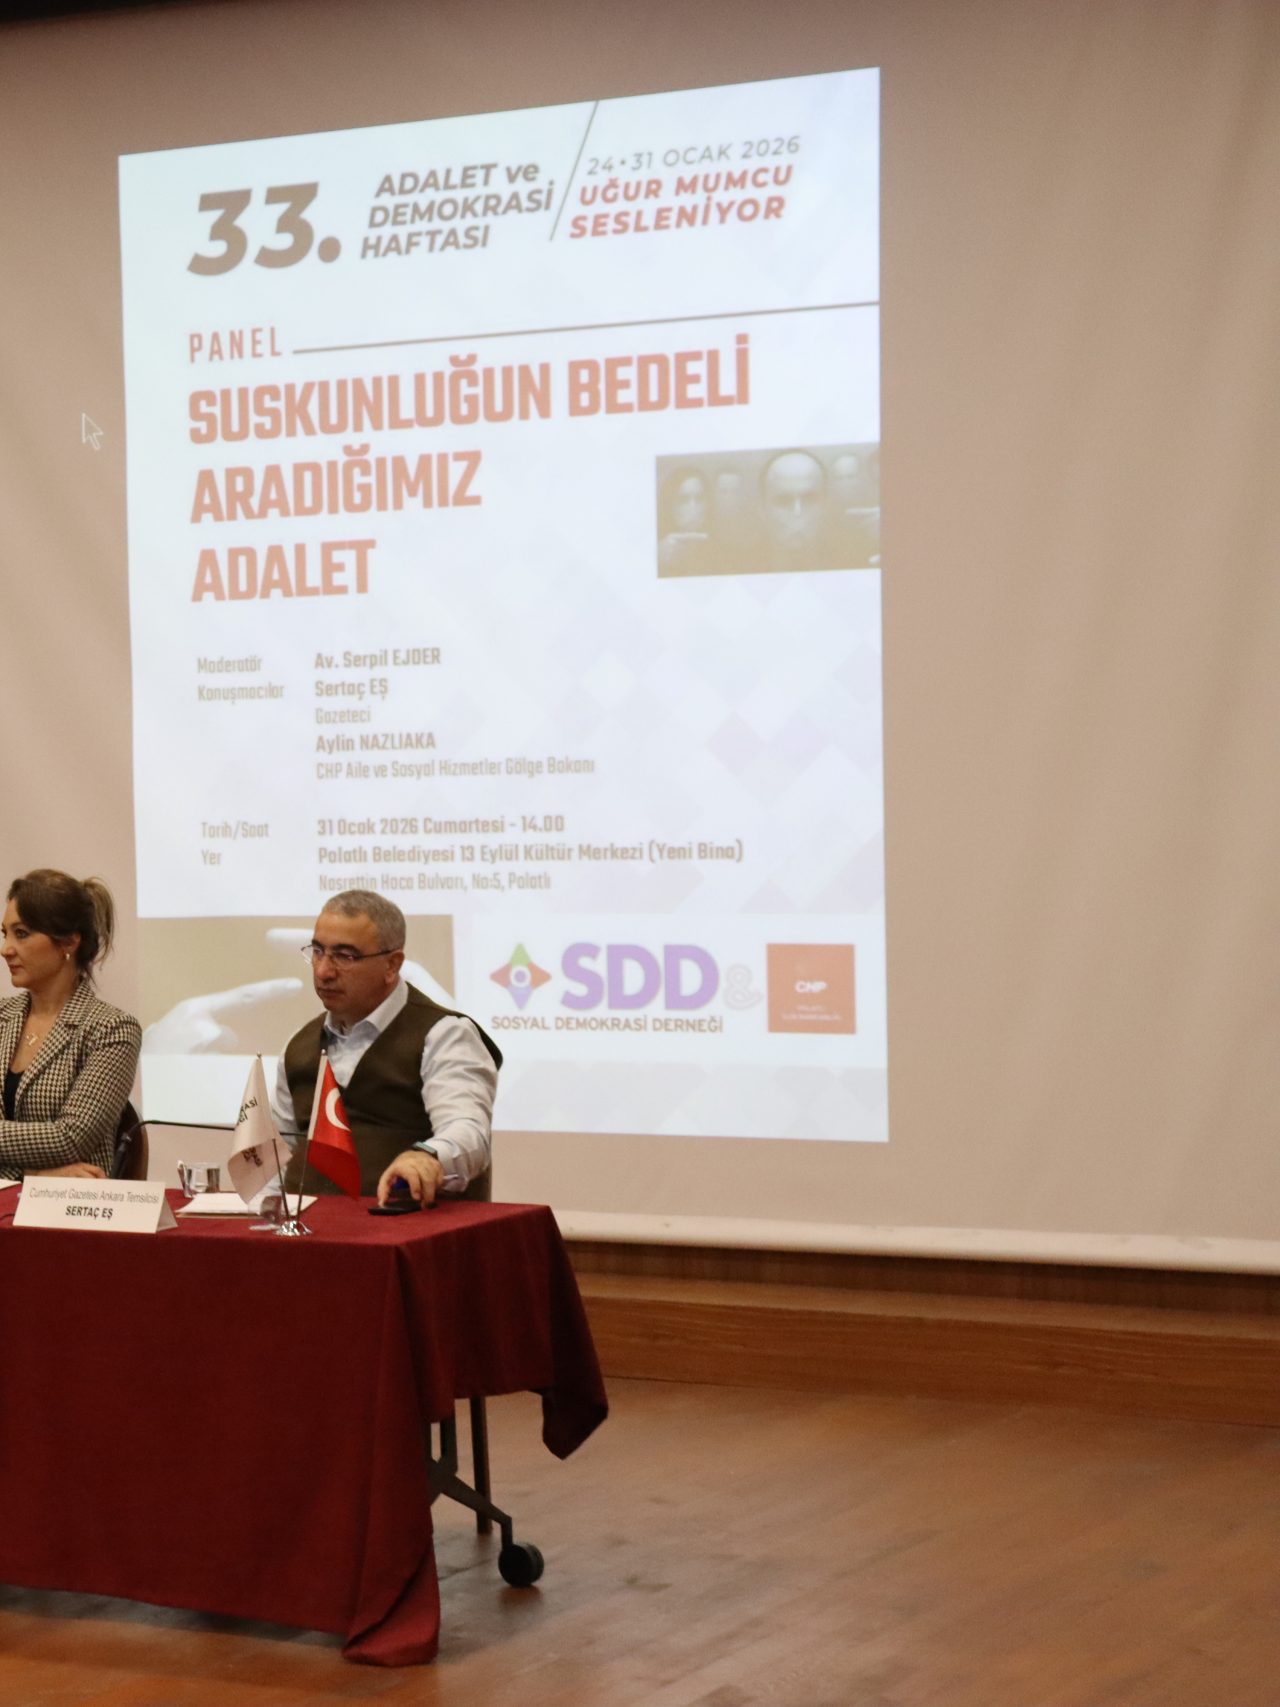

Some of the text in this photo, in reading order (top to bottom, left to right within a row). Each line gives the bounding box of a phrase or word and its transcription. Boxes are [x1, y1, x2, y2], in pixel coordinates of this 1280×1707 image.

[663, 143, 731, 168] OCAK
[741, 136, 801, 160] 2026
[374, 161, 540, 198] ADALET ve
[579, 165, 793, 208] UĞUR MUMCU
[367, 180, 554, 229] DEMOKRASİ
[569, 196, 787, 240] SESLENİYOR
[186, 182, 341, 276] 33.
[359, 225, 490, 260] HAFTASI
[189, 326, 282, 364] PANEL
[189, 333, 750, 444] SUSKUNLUĞUN BEDELİ
[190, 443, 482, 524] ARADIĞIMIZ
[190, 538, 376, 602] ADALET
[197, 647, 440, 673] Moderatör Av. Serpil EJDER
[198, 678, 388, 704] Konuşmacılar Sertaç EŞ
[315, 707, 371, 725] Gazeteci
[316, 732, 436, 754] Aylin NAZLIAKA
[316, 756, 594, 780] CHP Aile ve Sosyal Hizmetler Gölge Bakanı
[317, 819, 333, 836] 31
[338, 818, 375, 835] Ocak
[380, 818, 418, 835] 2026
[423, 815, 505, 835] Cumartesi
[521, 815, 564, 832] 14.00
[201, 838, 743, 866] Yer Polatlı Belediyesi 13 Eylül Kültür Merkezi (Yeni Bina)
[561, 942, 720, 1011] SDD
[491, 1015, 723, 1033] SOSYAL DEMOKRASİ DERNEĞİ
[29, 1187, 67, 1200] Cumhuriyet
[68, 1188, 98, 1200] Gazetesi
[100, 1190, 124, 1202] Ankara
[65, 1205, 113, 1220] SERTAÇ EŞ
